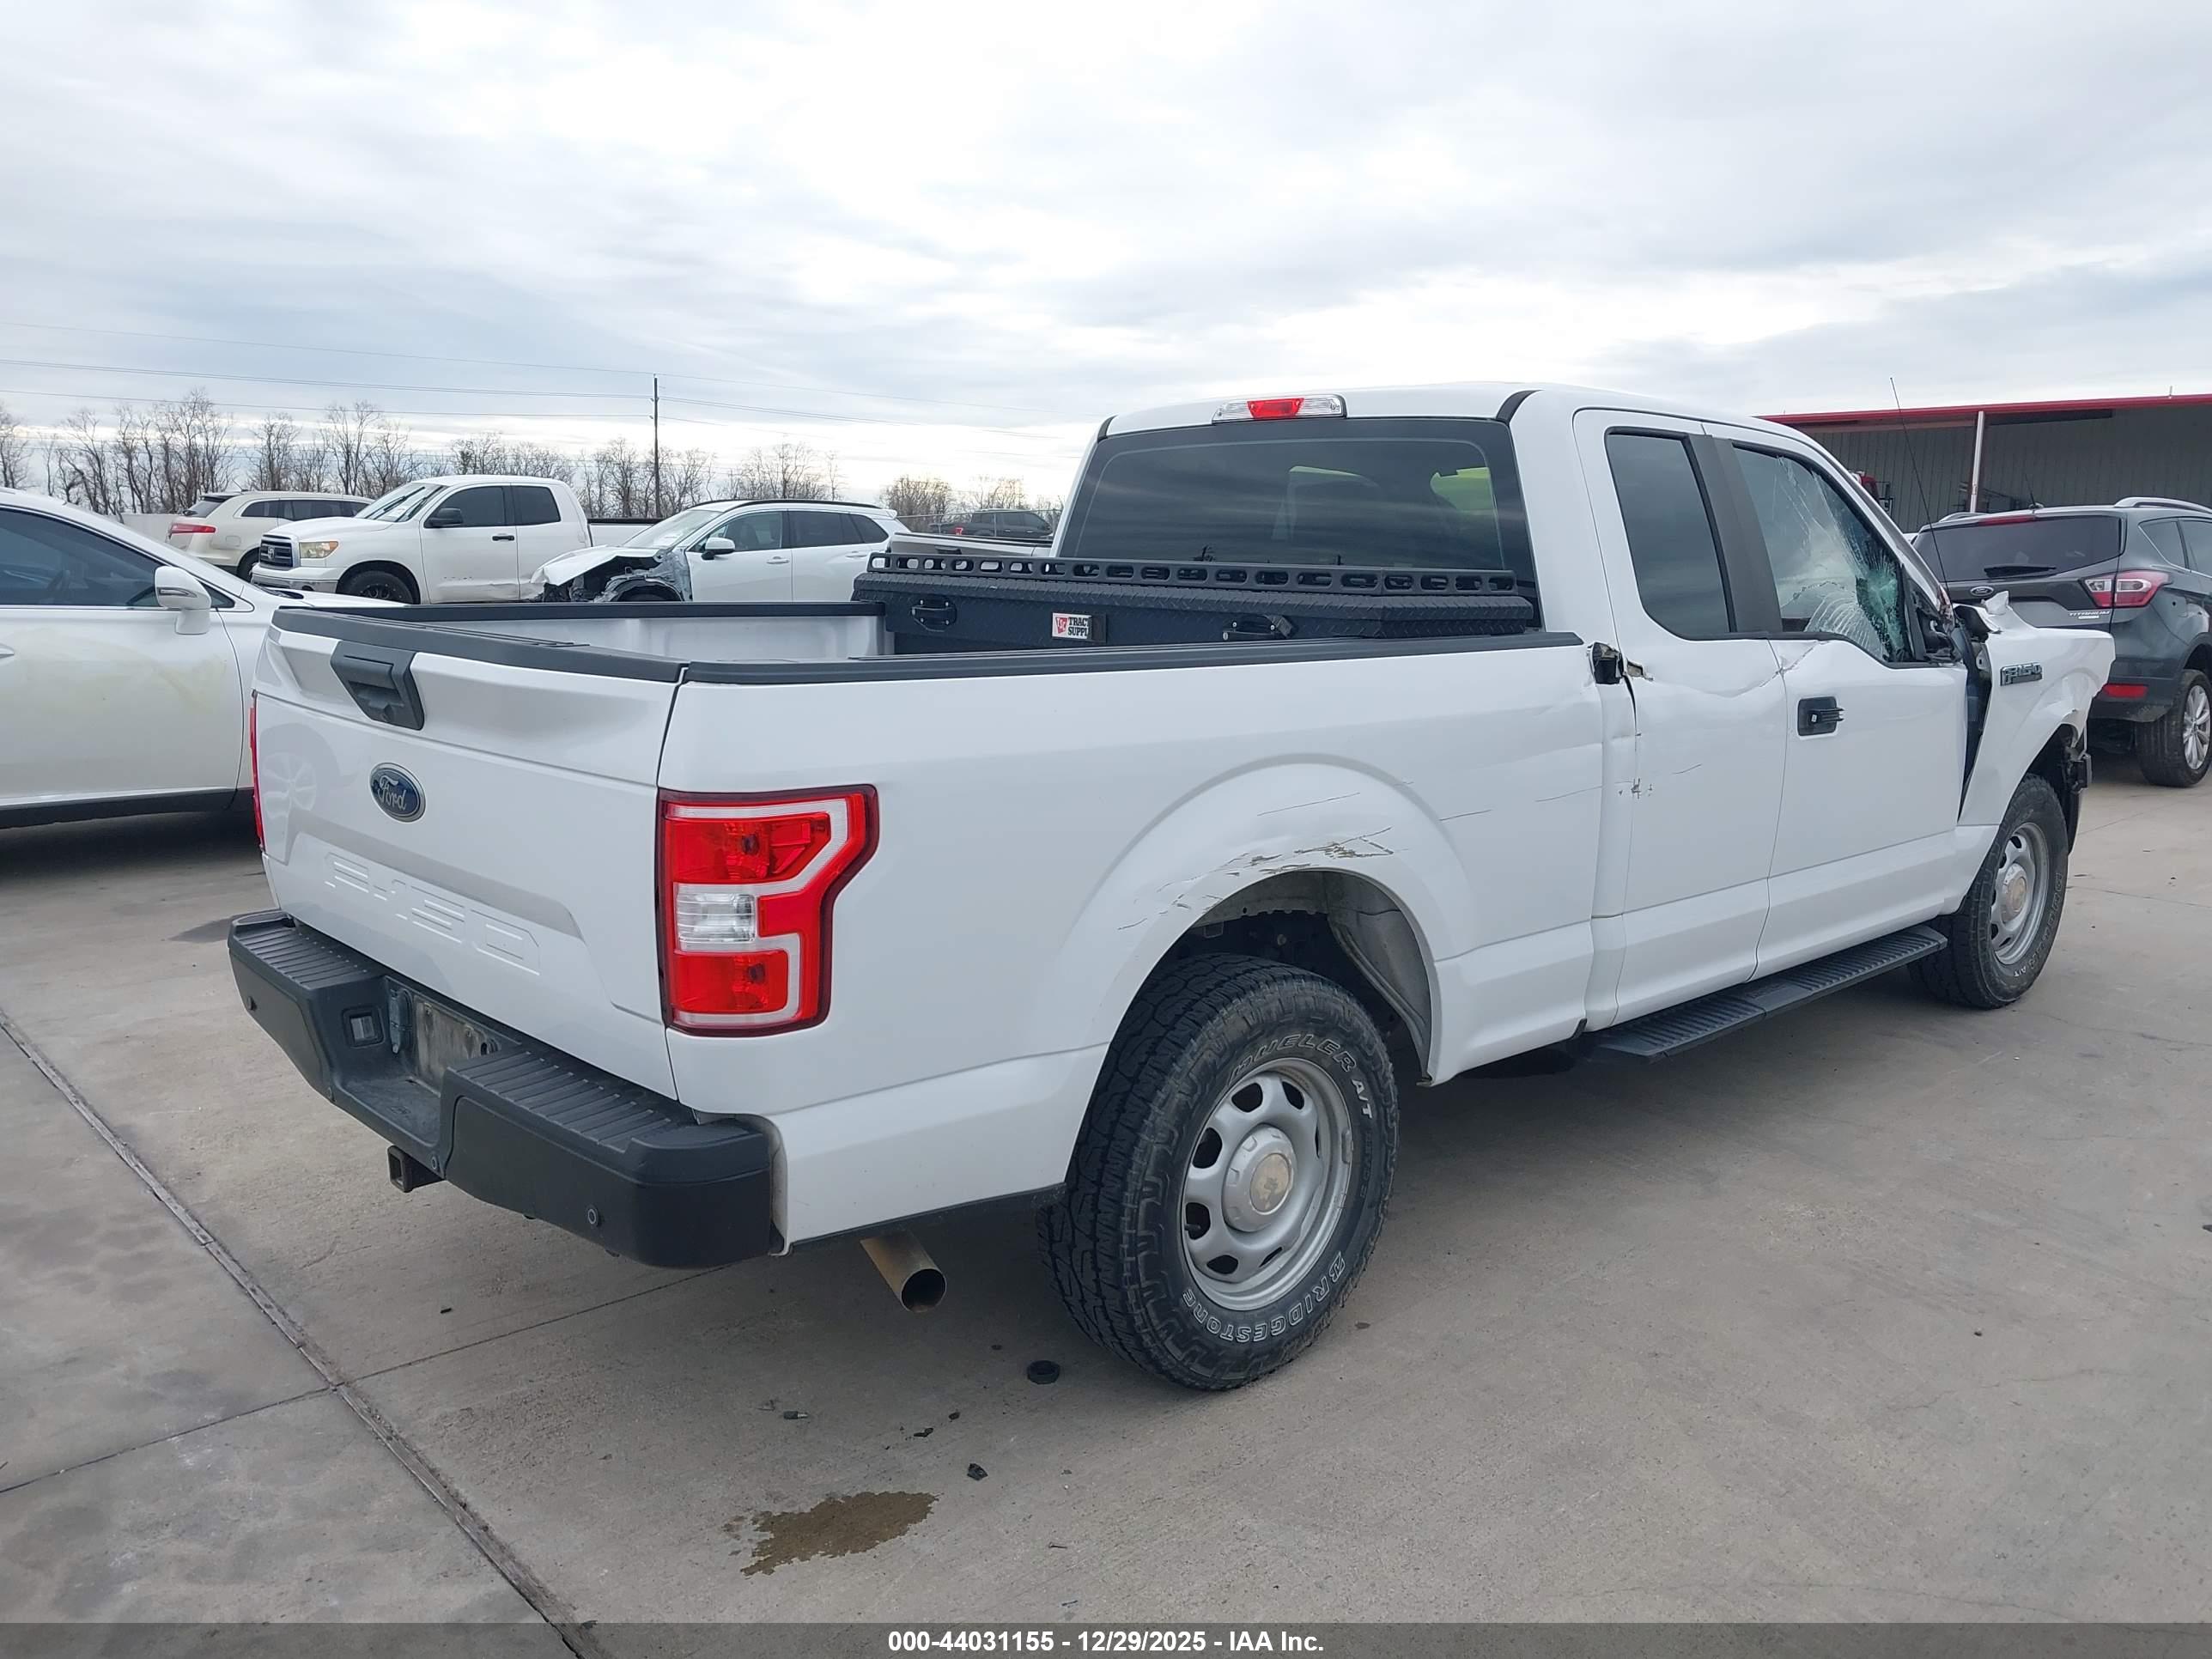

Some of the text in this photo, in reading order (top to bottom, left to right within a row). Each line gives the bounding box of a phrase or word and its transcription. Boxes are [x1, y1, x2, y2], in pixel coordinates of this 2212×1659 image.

[378, 775, 407, 811] Ford
[325, 851, 541, 976] F-150
[1352, 1079, 1374, 1119] A/T
[1182, 1250, 1346, 1343] BRIDGESTONE
